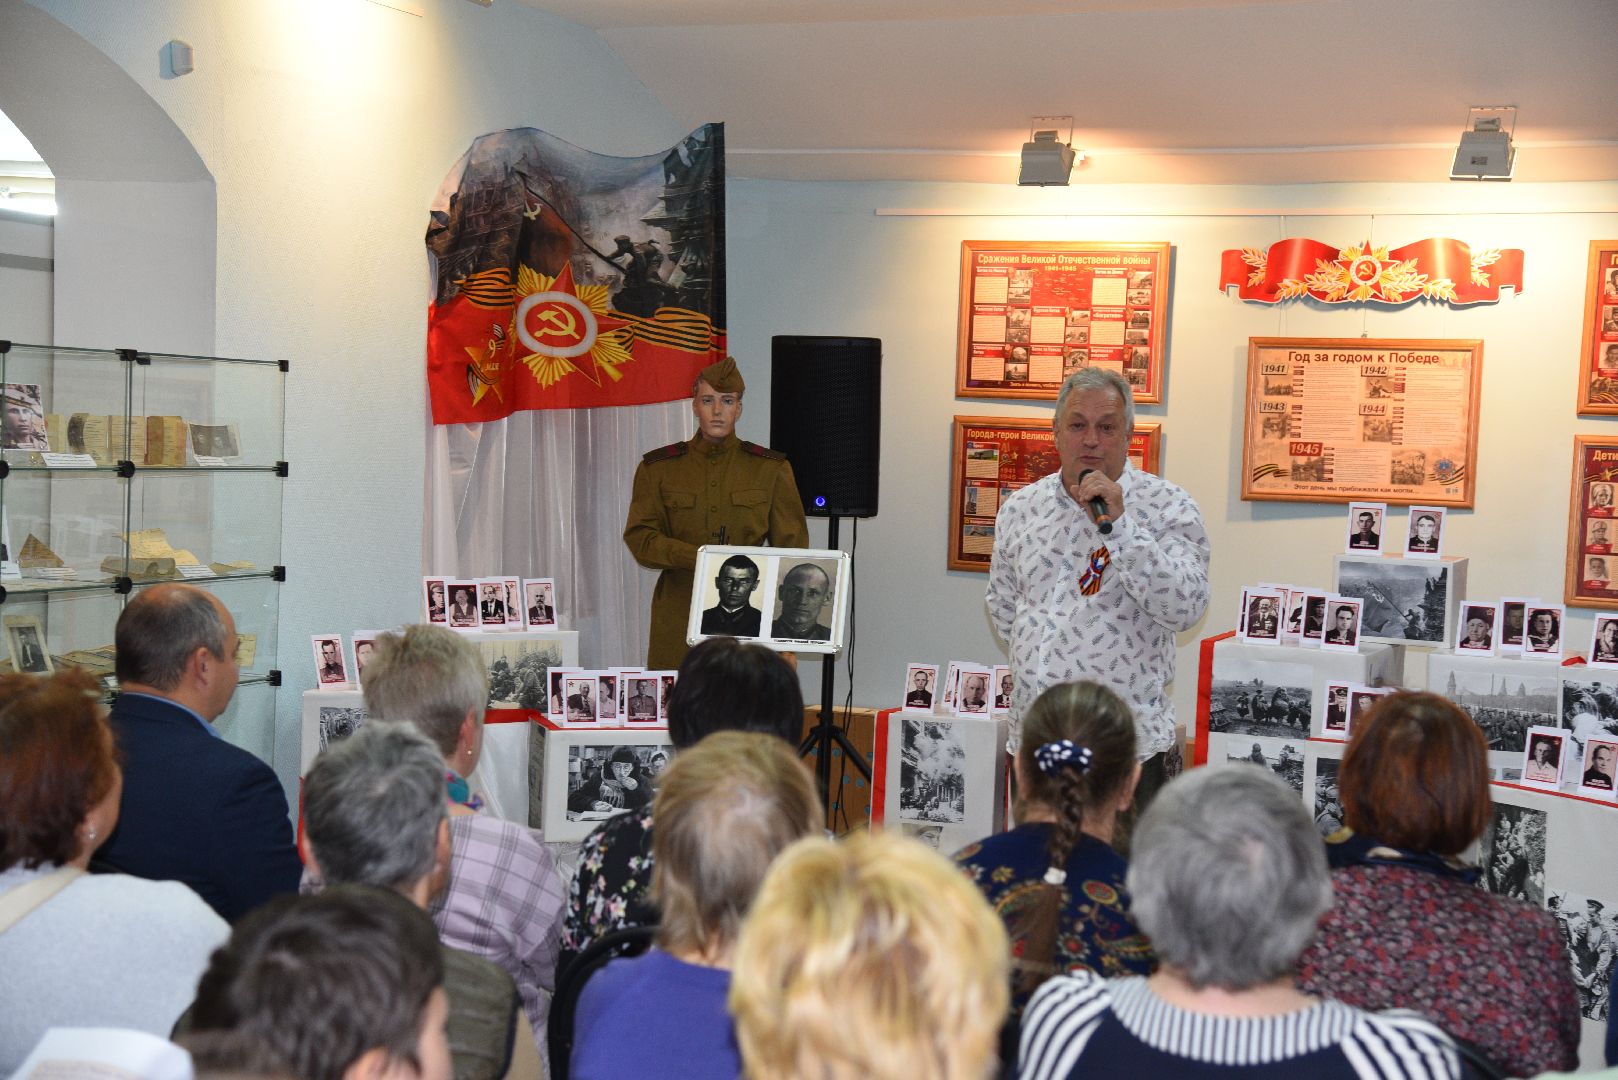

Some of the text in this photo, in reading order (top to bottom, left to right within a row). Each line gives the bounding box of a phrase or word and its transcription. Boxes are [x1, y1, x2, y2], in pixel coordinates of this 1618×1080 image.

[978, 254, 1150, 265] Сражения Великой Отечественной войны
[488, 339, 496, 358] 9
[1288, 351, 1439, 364] Год за годом к Победе
[1264, 364, 1286, 374] 1941
[1364, 366, 1387, 375] 1942
[1262, 402, 1285, 412] 1943
[1362, 404, 1385, 414] 1944
[968, 429, 1055, 441] Города-герои Великой
[1290, 444, 1320, 455] 1945
